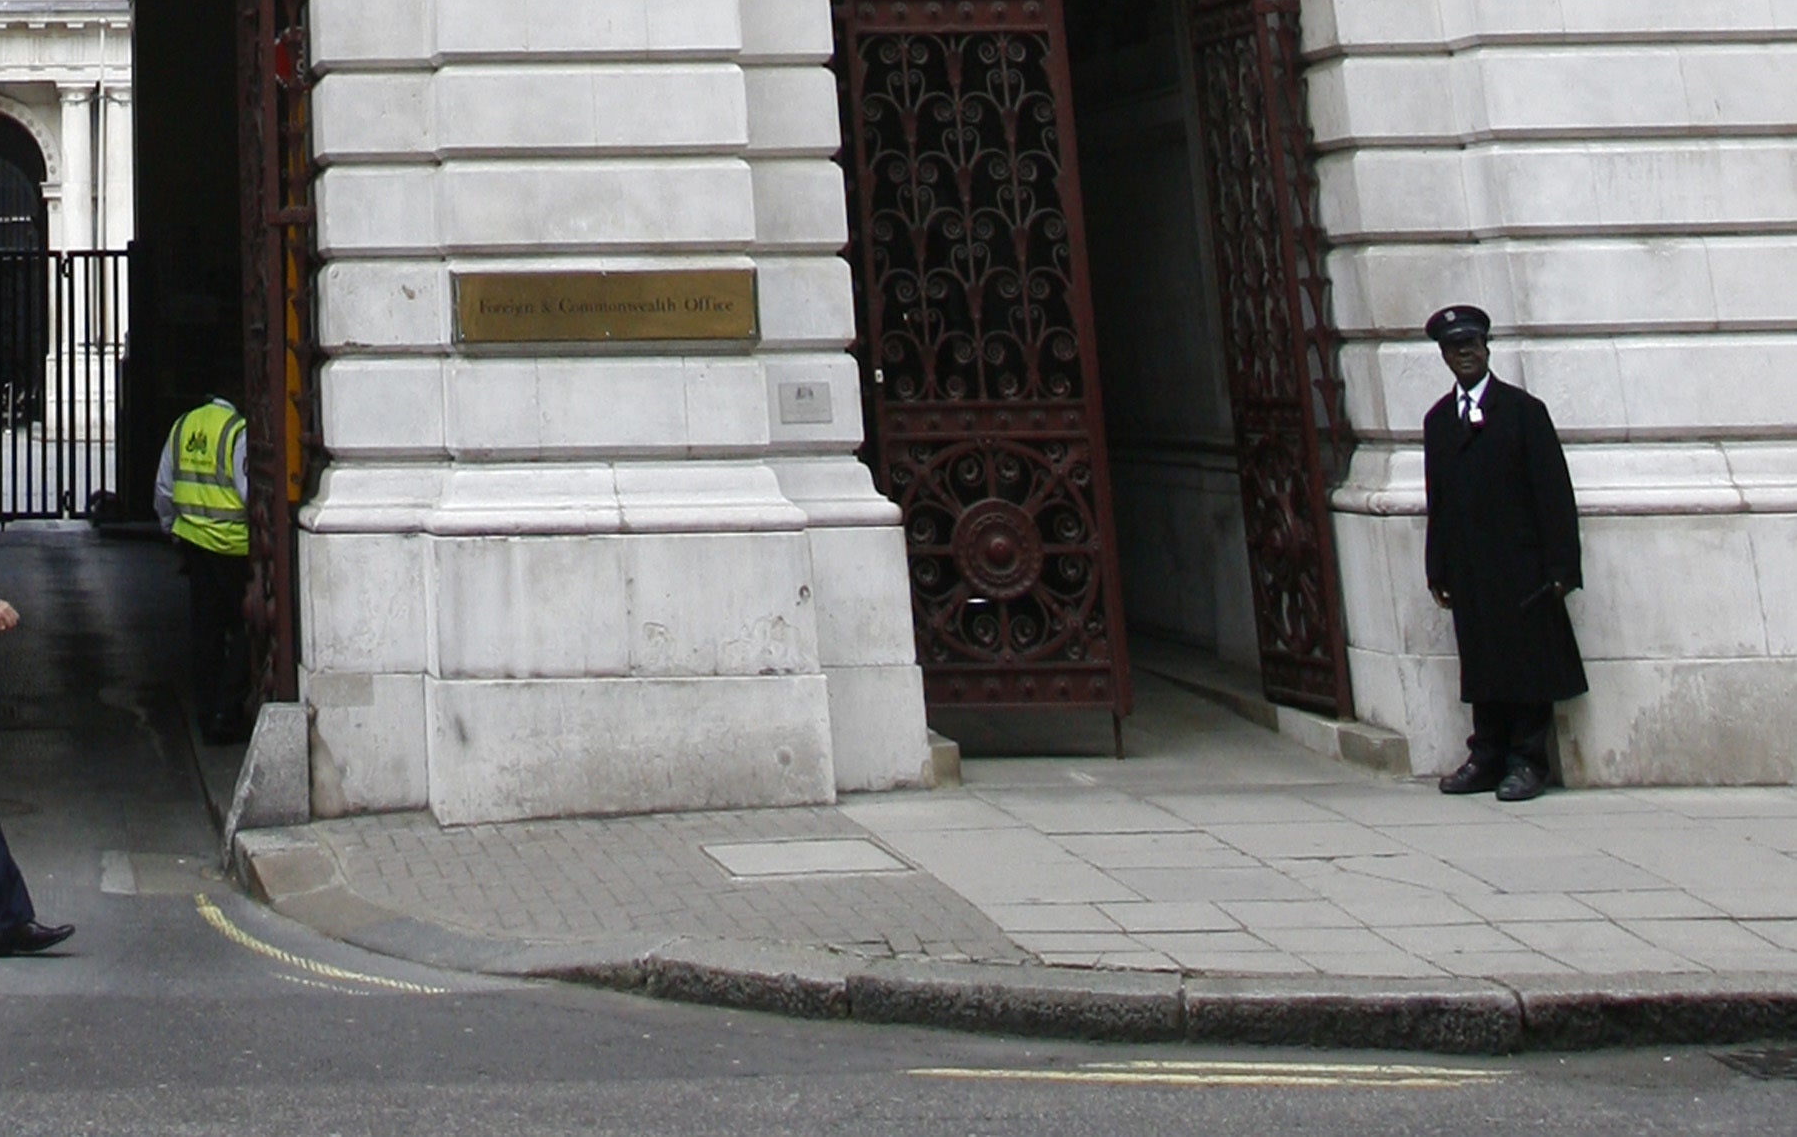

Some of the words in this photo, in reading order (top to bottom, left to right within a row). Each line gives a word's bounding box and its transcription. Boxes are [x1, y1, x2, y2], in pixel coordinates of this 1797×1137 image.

[479, 299, 534, 316] Foreign
[540, 299, 551, 313] &
[558, 298, 676, 313] Commonwealth
[684, 297, 734, 312] Office
